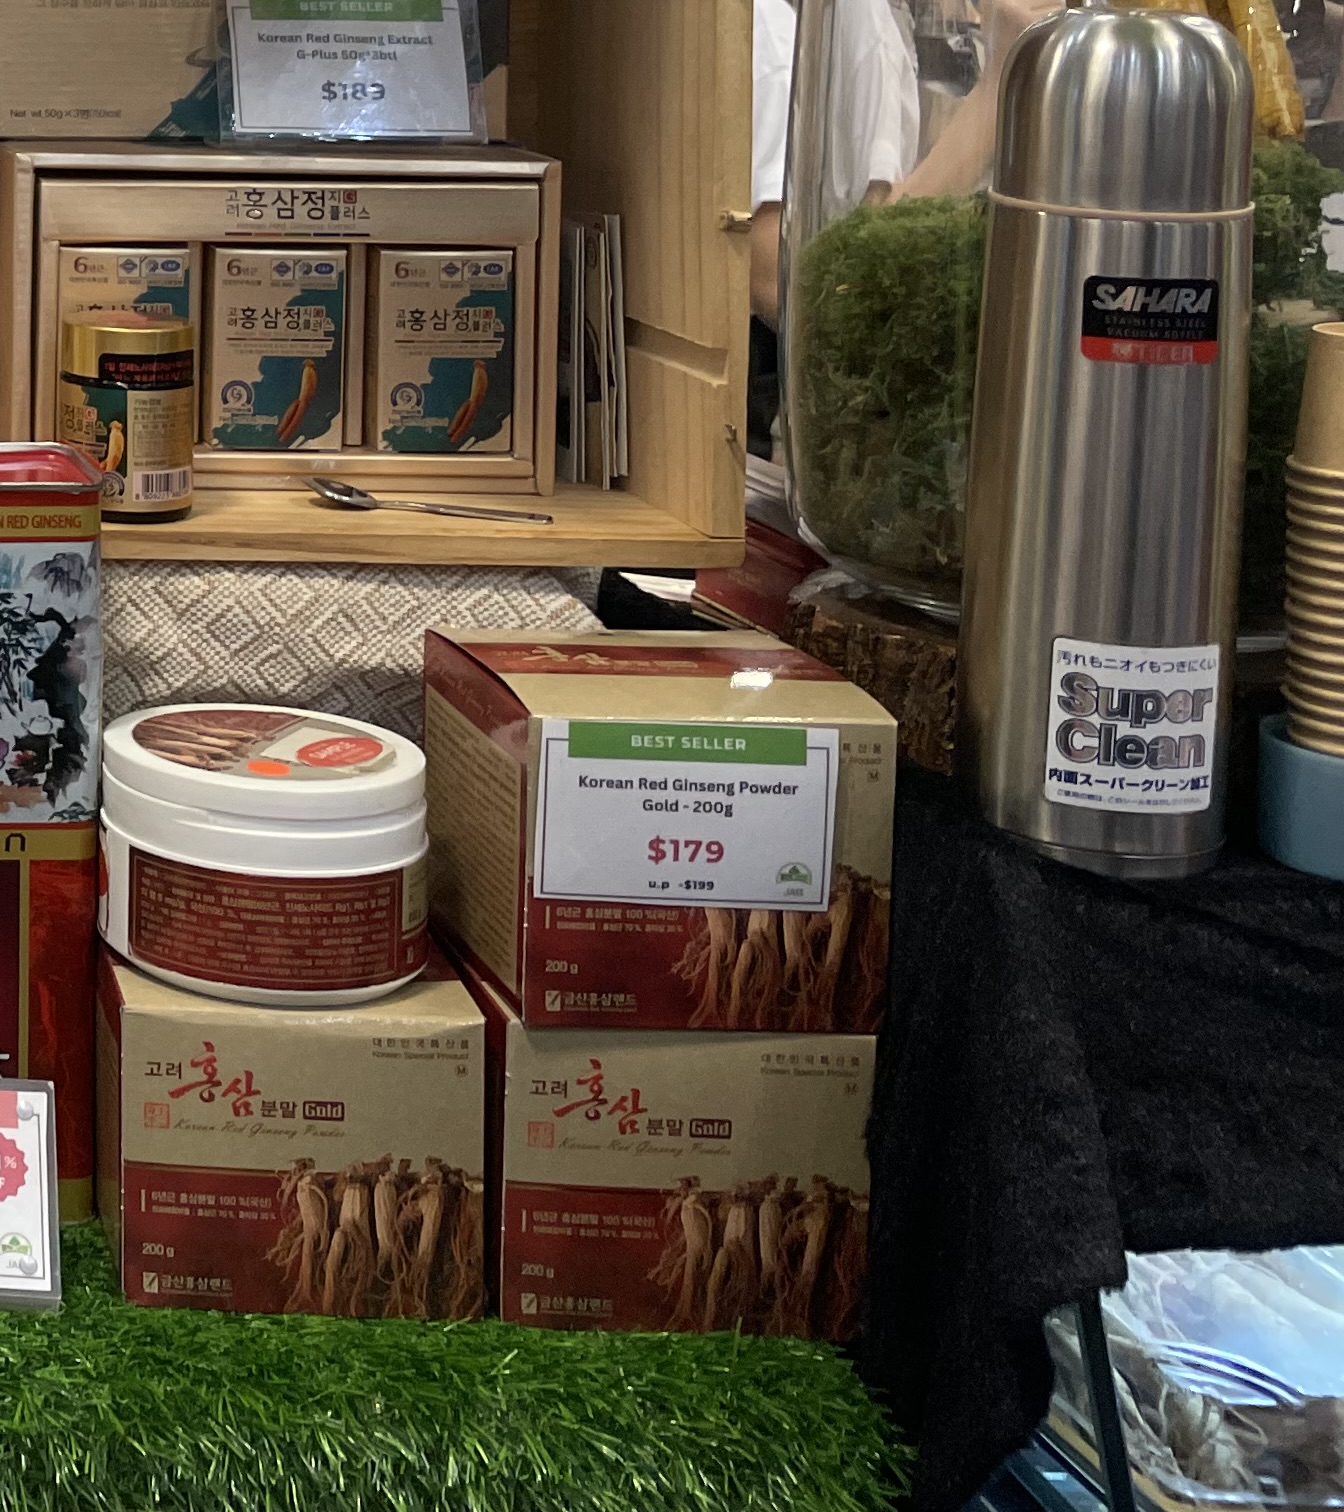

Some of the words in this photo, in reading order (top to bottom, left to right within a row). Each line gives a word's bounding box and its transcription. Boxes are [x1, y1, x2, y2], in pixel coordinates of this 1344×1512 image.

[1092, 284, 1212, 313] SAHARA
[1057, 672, 1213, 728] Super
[631, 734, 675, 748] BEST
[682, 736, 746, 750] SELLER
[1055, 718, 1206, 770] Clean
[578, 775, 633, 790] Korean
[638, 777, 668, 791] Red
[672, 778, 735, 796] Ginseng
[740, 780, 798, 796] Powder
[642, 799, 678, 812] Gold
[692, 800, 734, 818] 200g
[648, 835, 724, 865] $179
[305, 1104, 342, 1118] Gold
